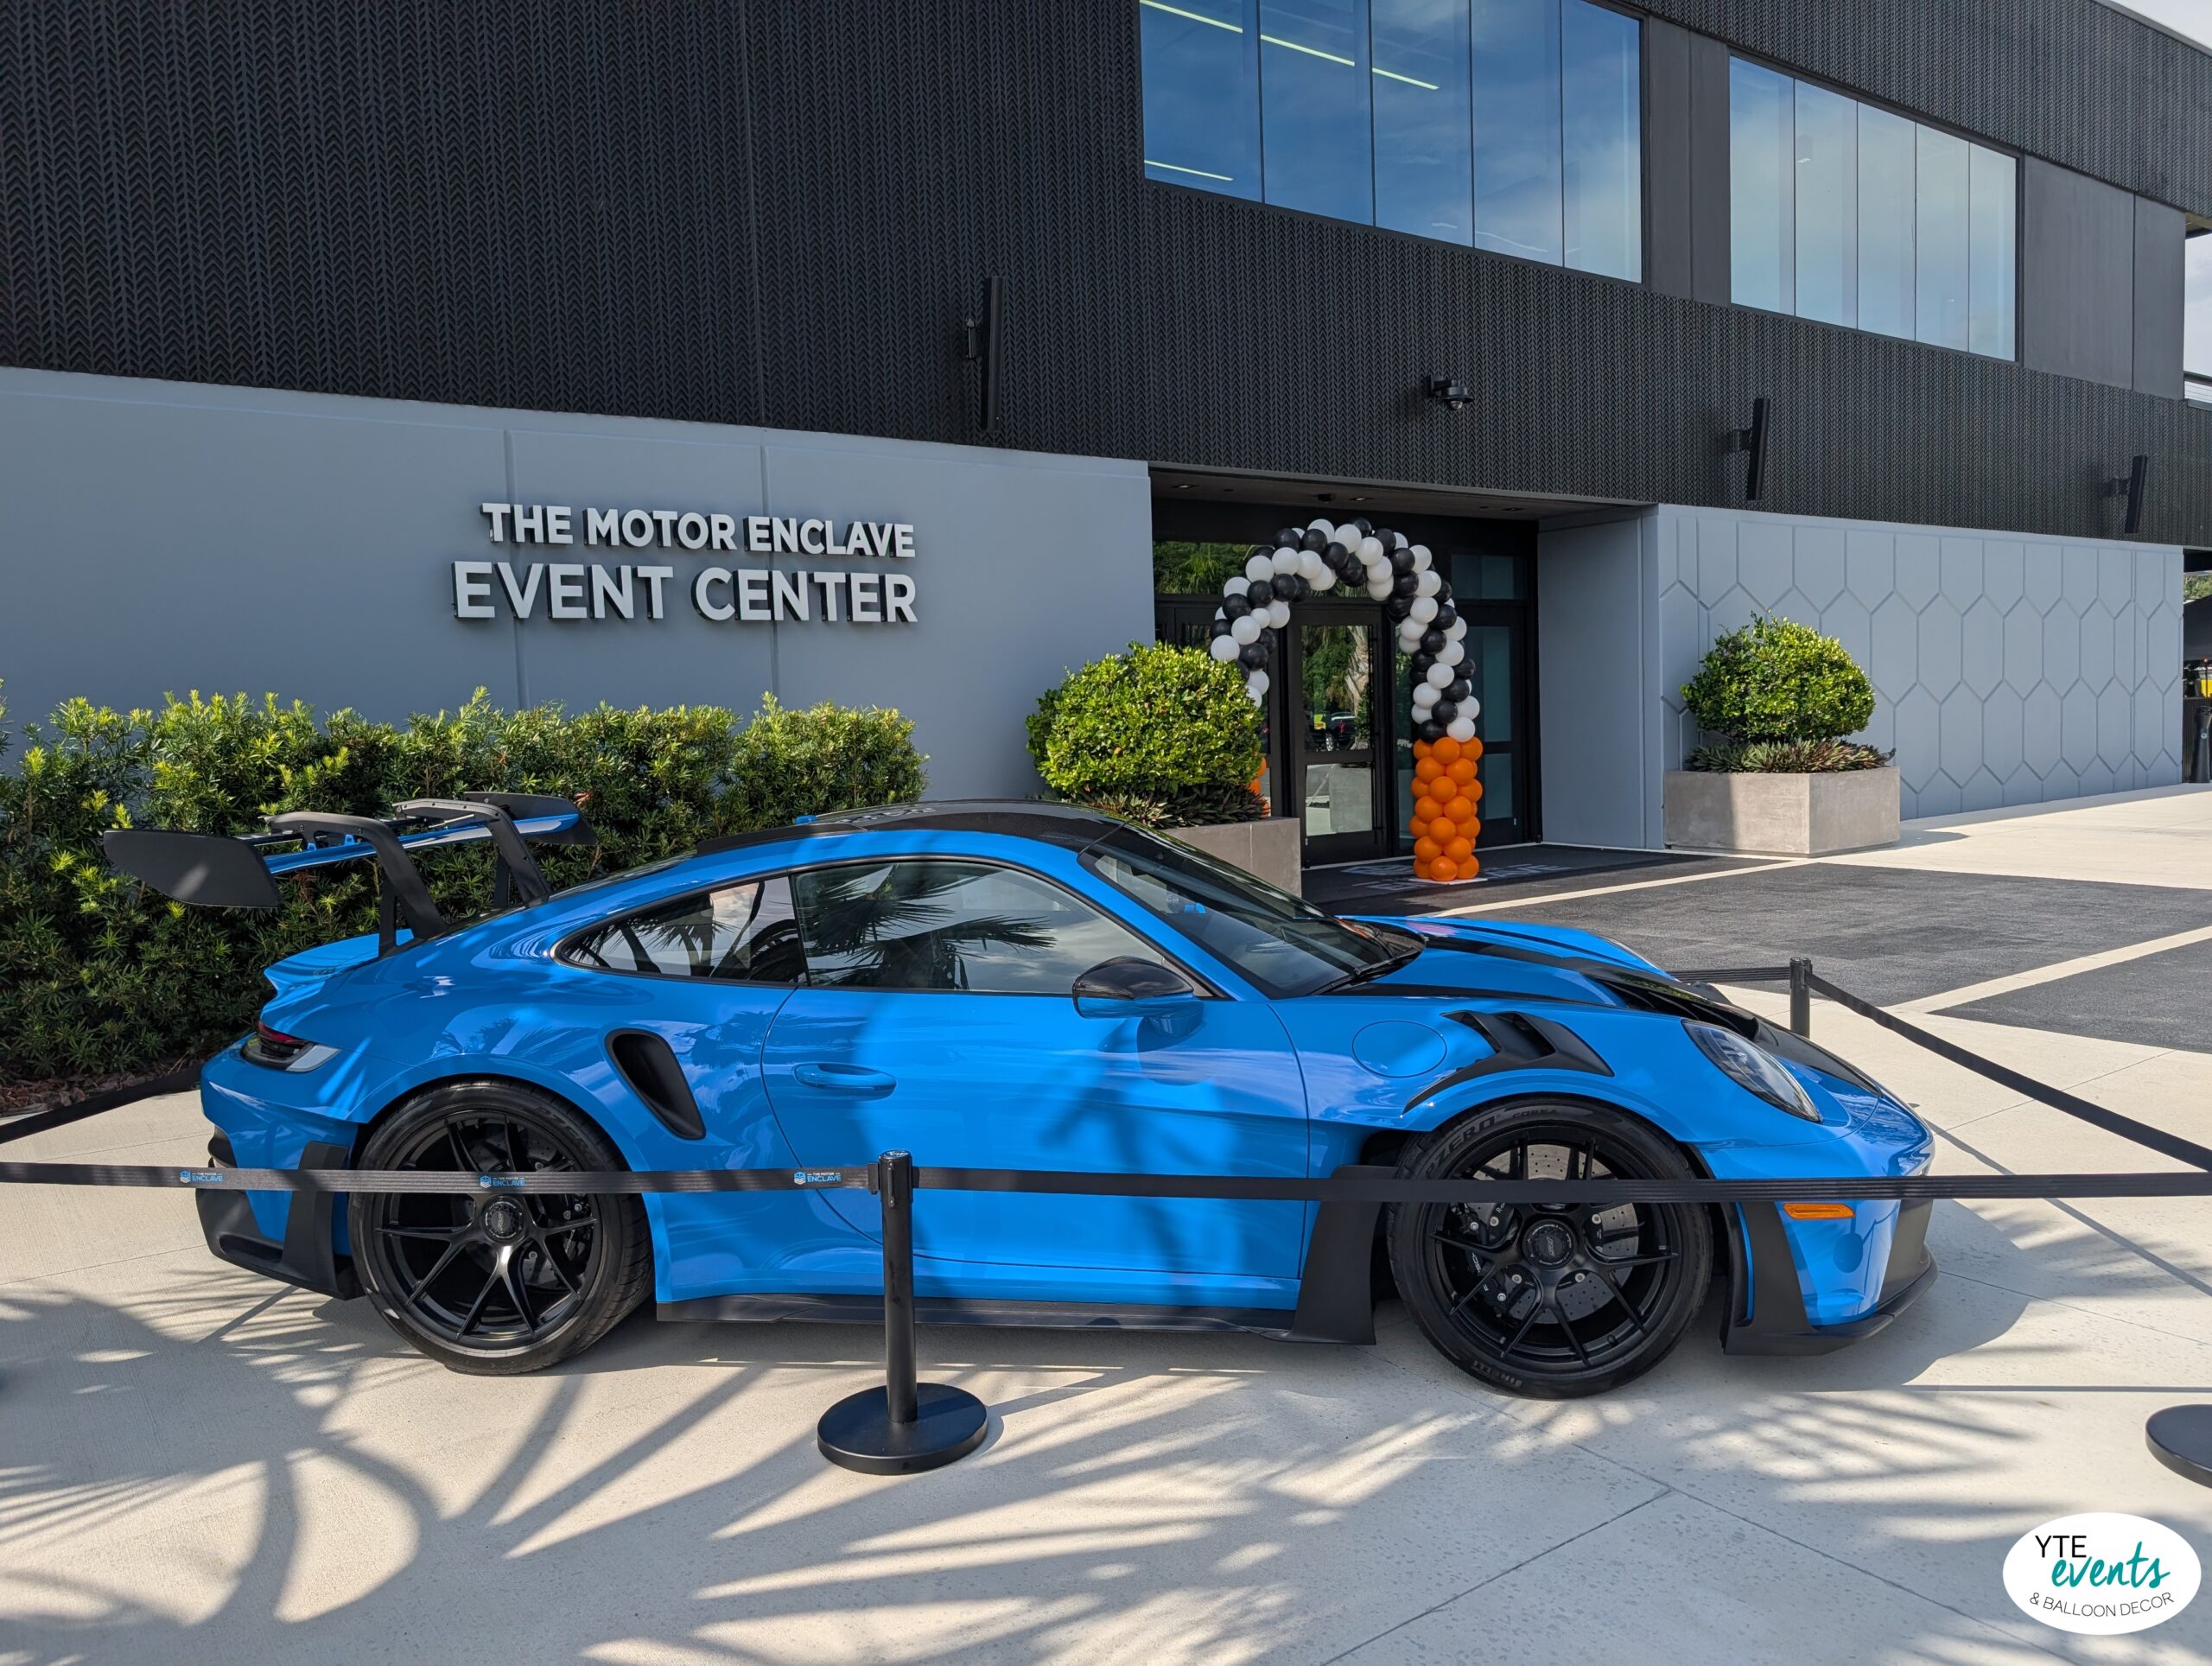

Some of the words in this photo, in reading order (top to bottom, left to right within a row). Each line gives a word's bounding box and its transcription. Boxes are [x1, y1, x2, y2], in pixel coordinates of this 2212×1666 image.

[480, 503, 573, 545] THE
[583, 507, 737, 551] MOTOR
[743, 515, 916, 558] ENCLAVE
[451, 561, 674, 620] EVENT
[691, 566, 918, 623] CENTER
